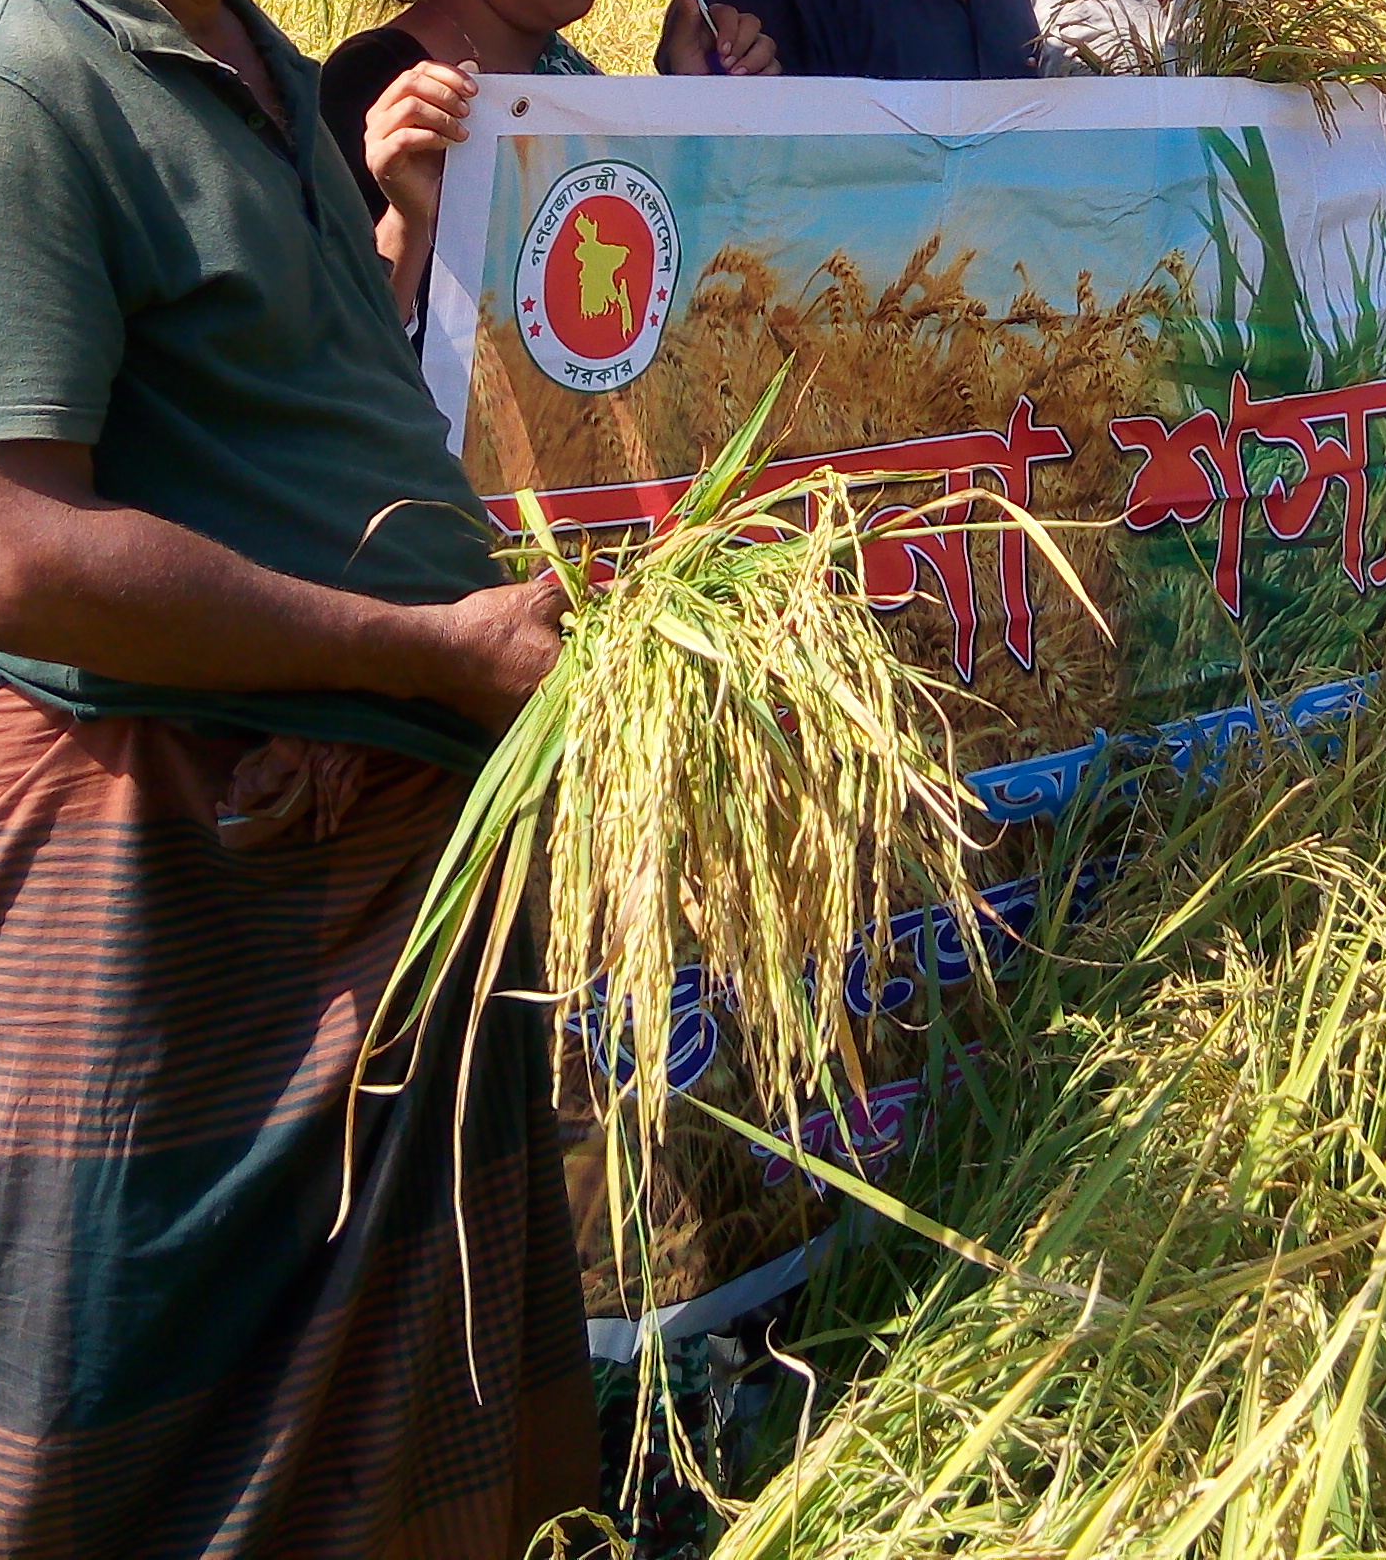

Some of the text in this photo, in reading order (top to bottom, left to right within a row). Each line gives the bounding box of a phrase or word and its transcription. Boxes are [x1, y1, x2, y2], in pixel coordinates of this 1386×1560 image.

[530, 167, 673, 274] গণপ্রজাতন্ত্রী বাংলাদেশ
[564, 359, 633, 387] সরকার
